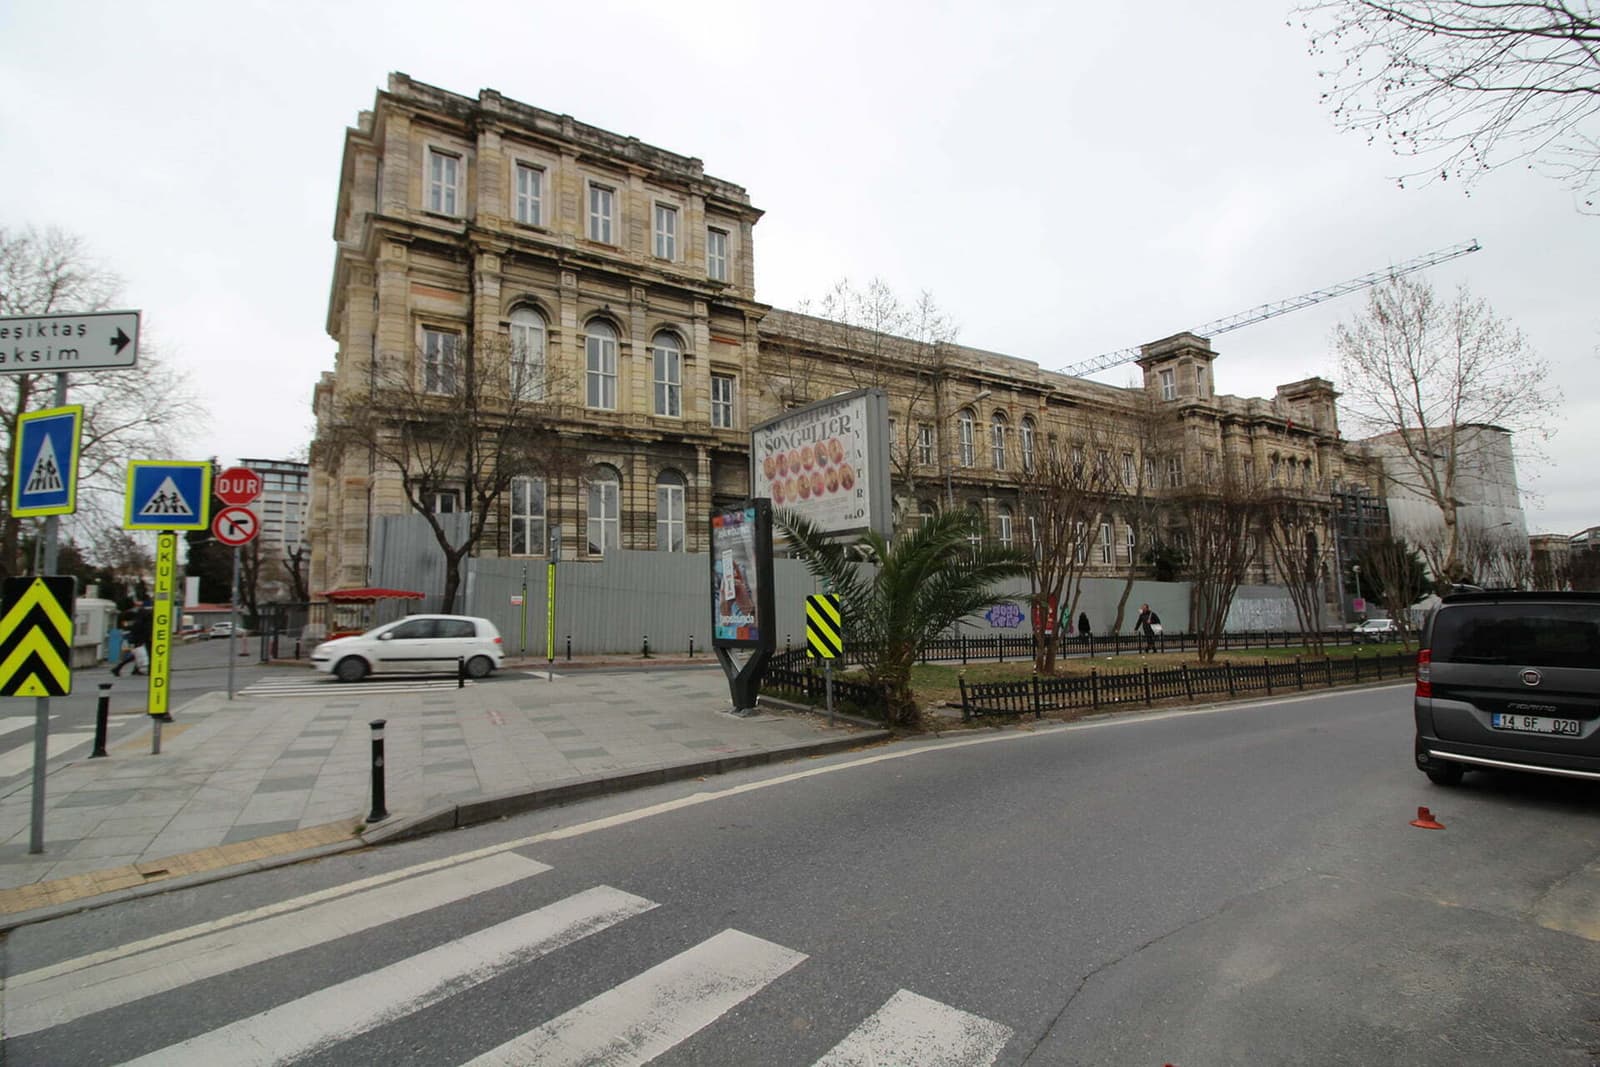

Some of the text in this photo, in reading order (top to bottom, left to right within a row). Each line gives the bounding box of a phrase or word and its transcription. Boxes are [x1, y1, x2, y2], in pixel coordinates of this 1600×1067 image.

[0, 346, 79, 363] aksim
[219, 479, 258, 494] DUR
[159, 537, 172, 591] OKUL
[1502, 715, 1577, 733] 14 GF 020
